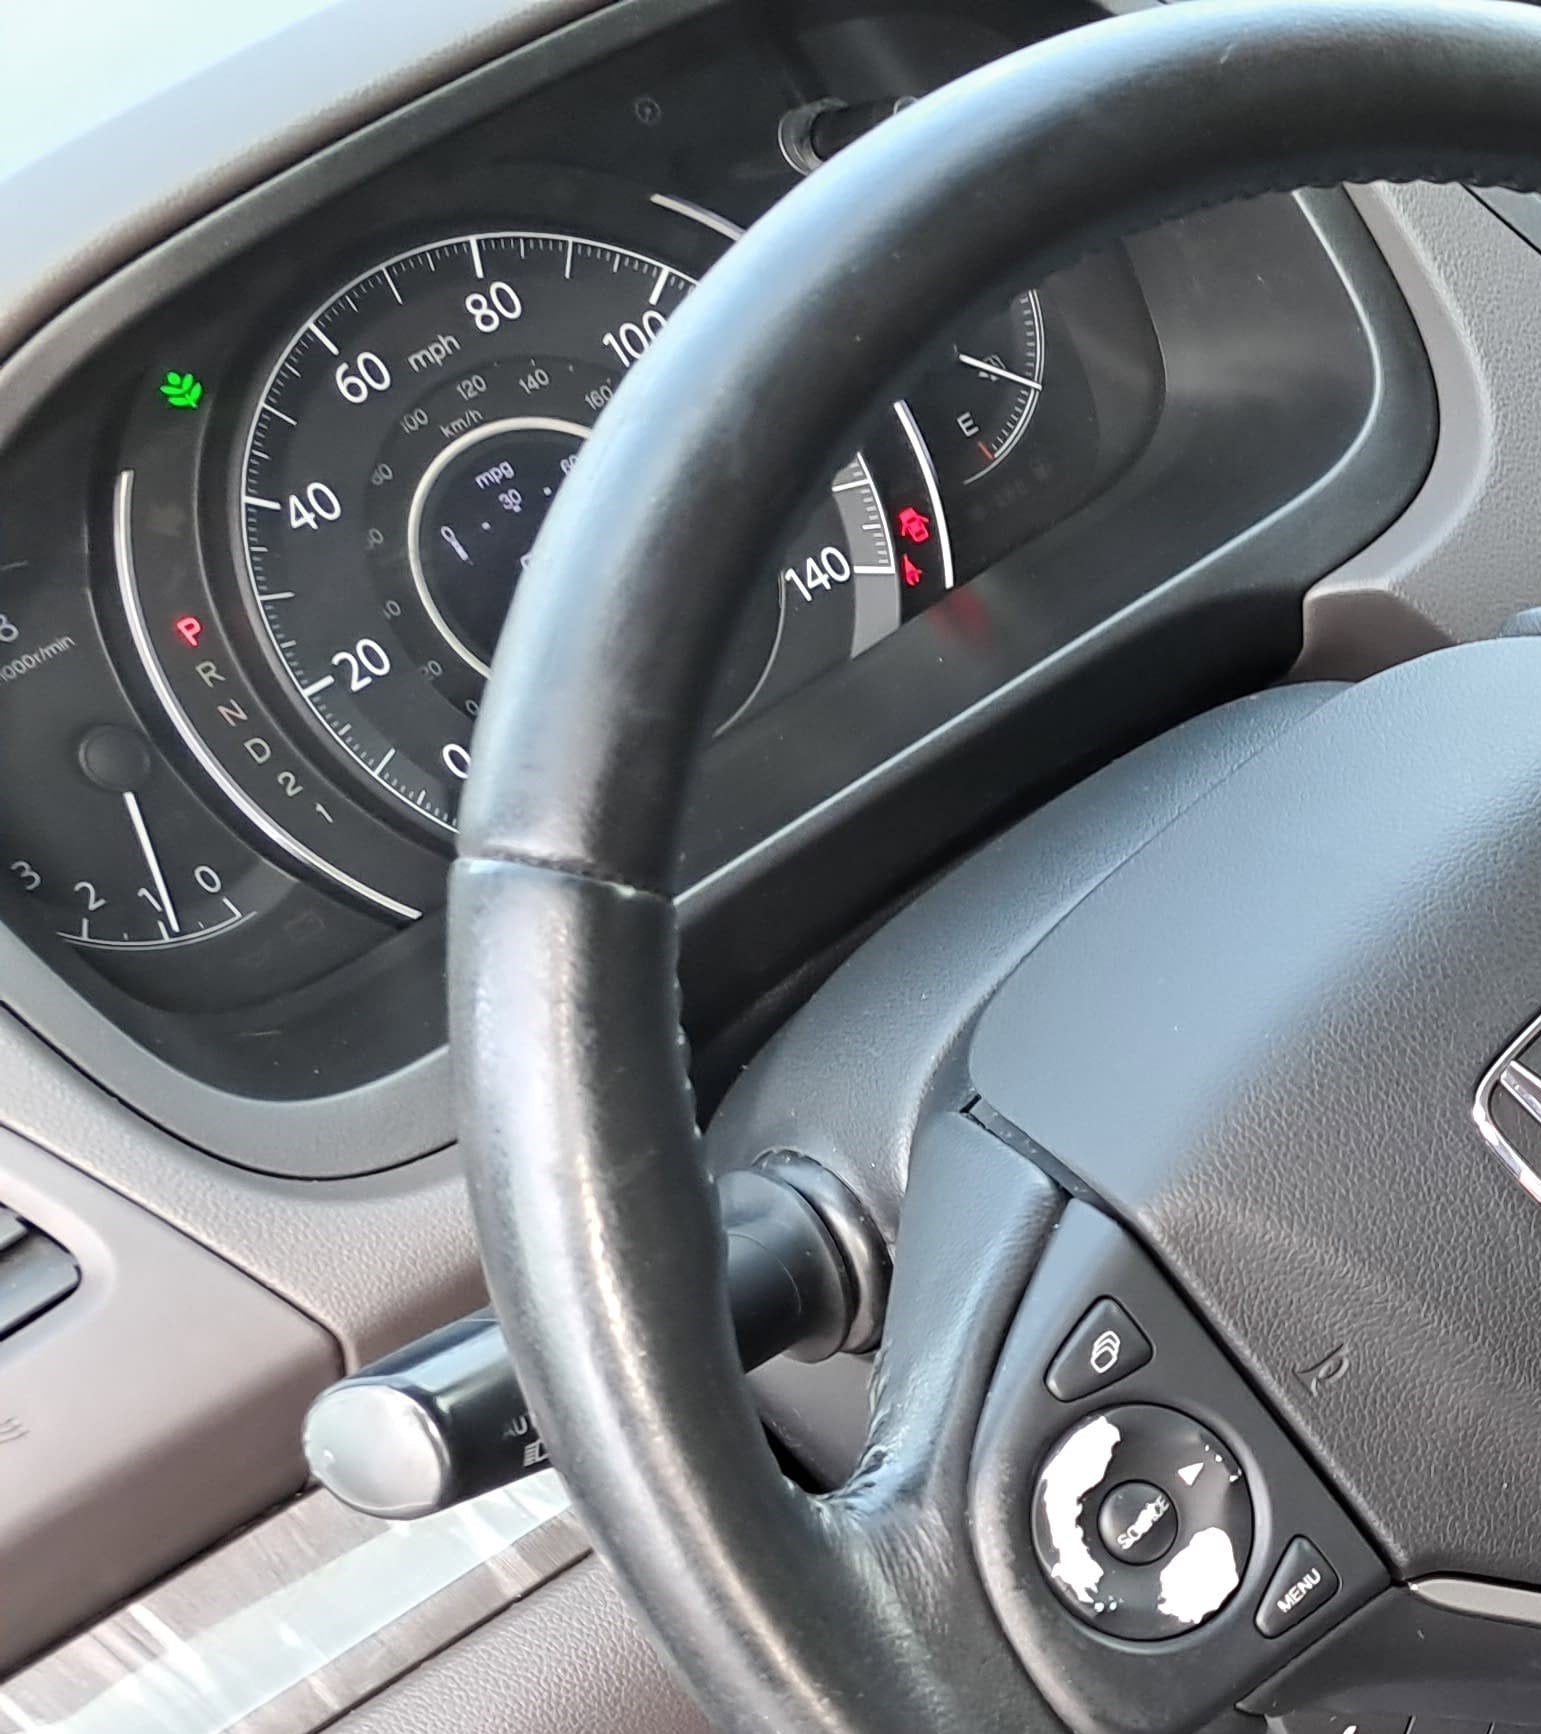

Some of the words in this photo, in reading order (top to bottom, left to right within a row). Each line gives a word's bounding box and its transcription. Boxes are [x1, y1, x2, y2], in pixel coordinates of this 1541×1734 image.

[465, 282, 522, 333] 80
[406, 331, 462, 374] mph
[603, 310, 668, 368] 100
[335, 351, 392, 404] 60
[456, 374, 487, 401] 120
[519, 368, 550, 394] 140
[401, 408, 428, 434] 100
[440, 409, 484, 439] km/h
[956, 413, 978, 438] E
[475, 460, 515, 489] mpg
[287, 481, 343, 533] 40
[498, 488, 522, 510] 30
[783, 544, 852, 602] 140
[177, 616, 202, 646] P
[196, 660, 226, 688] R
[331, 636, 392, 694] 20
[217, 699, 248, 727] N
[243, 737, 272, 764] D
[442, 743, 470, 779] 0
[278, 770, 303, 796] 2
[316, 803, 335, 824] 1
[10, 860, 42, 890] 3
[194, 865, 222, 893] 0
[74, 881, 106, 911] 2
[137, 887, 163, 912] 1
[1277, 1567, 1321, 1614] MENU
